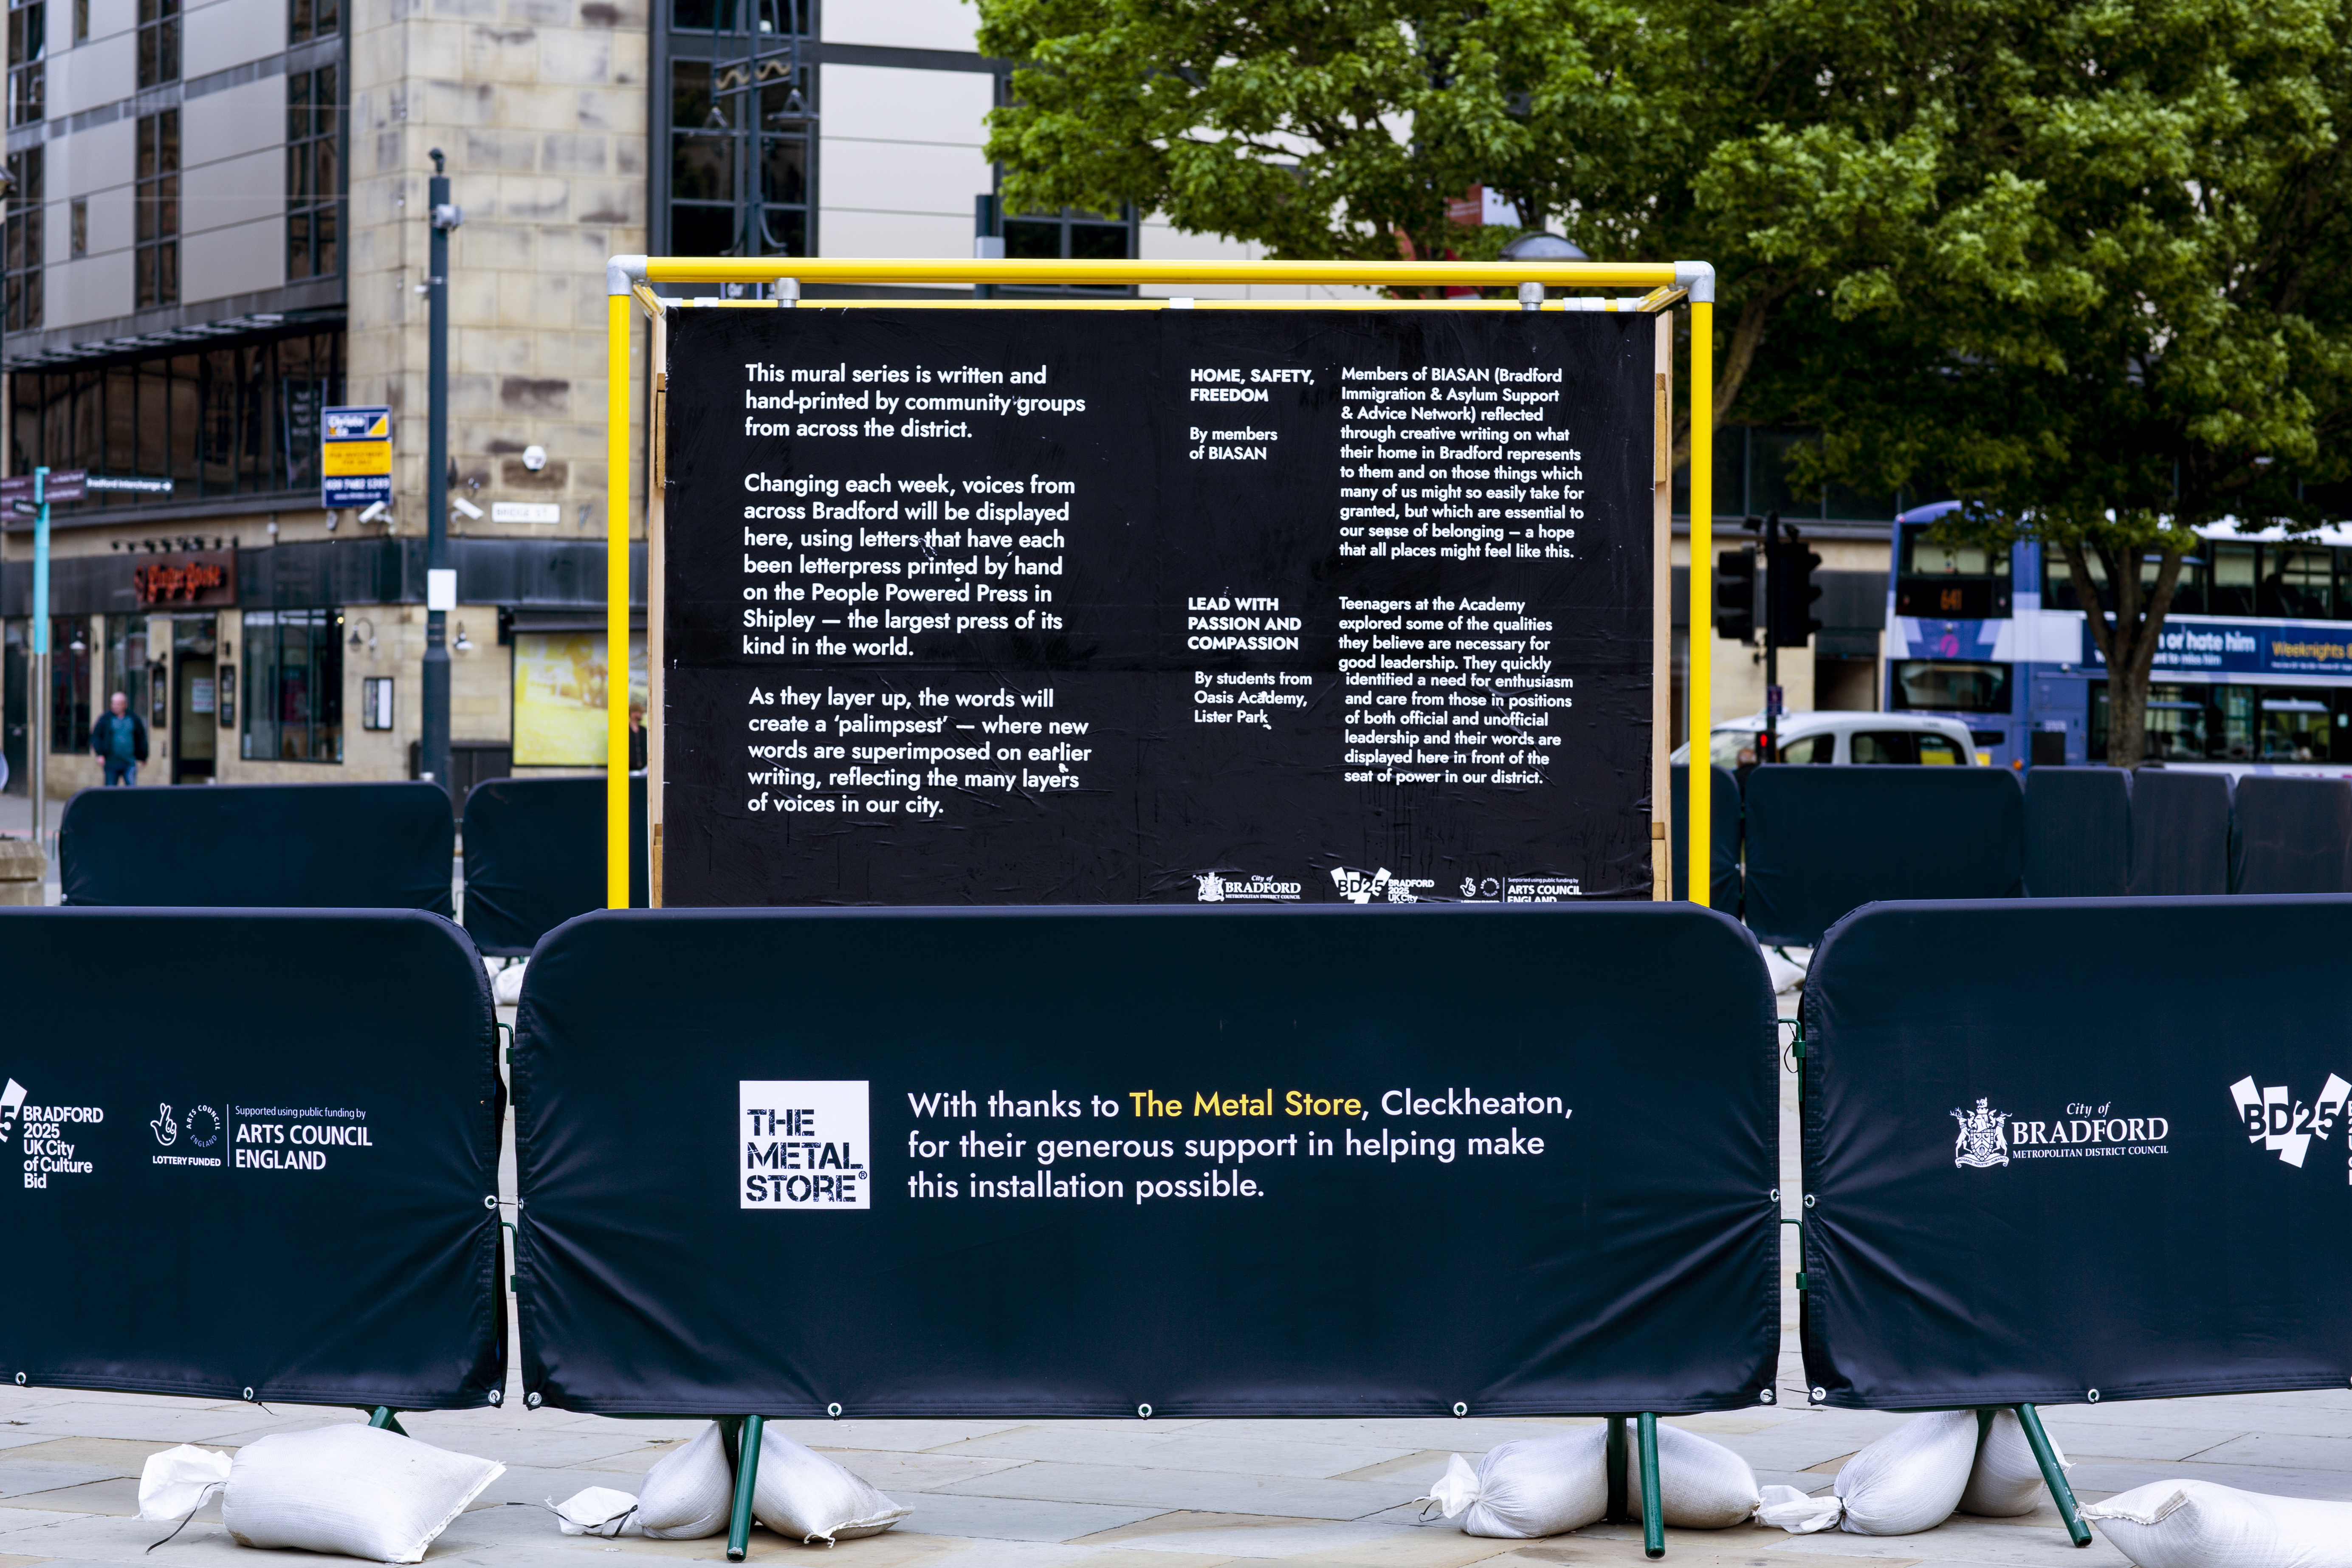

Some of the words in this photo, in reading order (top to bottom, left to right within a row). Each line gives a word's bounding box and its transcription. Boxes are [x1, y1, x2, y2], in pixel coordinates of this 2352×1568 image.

[745, 362, 784, 382] This
[792, 363, 845, 382] mural
[852, 365, 909, 382] series
[917, 365, 931, 383] is
[937, 366, 1003, 383] written
[1010, 365, 1046, 384] and
[1191, 369, 1245, 384] HOME,
[1250, 369, 1314, 385] SAFETY,
[1342, 366, 1408, 381] Members
[1413, 367, 1427, 381] of
[1432, 368, 1489, 381] BIASAN
[1495, 367, 1562, 384] (Bradford
[746, 389, 868, 414] hand-printed
[876, 390, 899, 414] by
[905, 393, 1011, 415] community
[1017, 397, 1085, 416] groups
[1191, 389, 1268, 402] FREEDOM
[1342, 386, 1425, 403] Immigration
[1430, 387, 1442, 400] &
[1446, 386, 1497, 404] Asylum
[1503, 388, 1560, 405] Support
[1341, 406, 1353, 419] &
[1357, 405, 1407, 419] Advice
[1412, 406, 1475, 423] Network)
[1481, 406, 1543, 421] reflected
[745, 416, 789, 436] from
[797, 424, 858, 437] across
[864, 417, 894, 437] the
[901, 418, 972, 437] district.
[1190, 445, 1205, 459] of
[1209, 447, 1266, 460] BIASAN
[86, 478, 117, 488] Bradford
[119, 479, 161, 491] Interchange
[745, 472, 838, 497] Changing
[846, 473, 891, 492] each
[898, 474, 955, 496] week,
[962, 476, 1024, 494] voices
[1030, 474, 1074, 494] from
[744, 506, 805, 519] across
[813, 500, 898, 519] Bradford
[905, 501, 937, 520] will
[945, 501, 969, 520] be
[976, 501, 1069, 525] displayed
[1189, 597, 1230, 610] LEAD
[1235, 598, 1278, 611] WITH
[1339, 597, 1411, 613] Teenagers
[1416, 599, 1429, 610] at
[1432, 596, 1455, 610] the
[1459, 597, 1525, 614] Academy
[1940, 588, 1962, 611] 641
[1188, 617, 1260, 630] PASSION
[1264, 618, 1301, 630] AND
[1339, 615, 1401, 632] explored
[1406, 620, 1444, 629] some
[1448, 616, 1463, 630] of
[1466, 616, 1489, 630] the
[1493, 616, 1552, 634] qualities
[1188, 636, 1298, 650] COMPASSION
[2186, 631, 2223, 651] hate
[2225, 631, 2256, 652] him
[2272, 641, 2345, 662] Weeknights
[1195, 671, 1213, 687] By
[1217, 672, 1275, 685] students
[1280, 672, 1312, 685] from
[1195, 691, 1234, 703] Oasis
[1238, 690, 1307, 708] Academy,
[1195, 710, 1232, 722] Lister
[1238, 709, 1268, 723] Park
[1226, 882, 1301, 894] BRADFORD
[1388, 880, 1434, 888] BRADFORD
[1508, 885, 1535, 894] ARTS
[1537, 885, 1582, 895] COUNCIL
[1403, 894, 1418, 903] City
[236, 1106, 276, 1117] Supported
[278, 1109, 297, 1118] using
[300, 1107, 323, 1118] public
[325, 1108, 354, 1120] funding
[356, 1108, 366, 1120] by
[908, 1090, 976, 1118] With
[988, 1090, 1081, 1117] thanks
[1091, 1095, 1119, 1117] to
[1130, 1090, 1182, 1117] The
[1194, 1089, 1272, 1116] Metal
[1285, 1091, 1368, 1120] Store,
[1382, 1088, 1572, 1119] Cleckheaton,
[2067, 1103, 2092, 1118] City
[2098, 1102, 2110, 1117] of
[23, 1106, 103, 1122] BRADFORD
[186, 1108, 196, 1129] ARTS
[198, 1105, 220, 1130] COUNCIL
[747, 1109, 815, 1136] THE
[2244, 1101, 2339, 1137] BD25
[24, 1122, 59, 1138] 2025
[236, 1124, 284, 1143] ARTS
[290, 1125, 372, 1146] COUNCIL
[2012, 1117, 2169, 1145] BRADFORD
[24, 1139, 45, 1155] UK
[46, 1140, 74, 1159] City
[190, 1134, 217, 1148] ENGLAND
[908, 1130, 950, 1157] for
[959, 1131, 1027, 1157] their
[1038, 1140, 1173, 1165] generous
[1185, 1134, 1297, 1163] support
[1309, 1131, 1332, 1155] in
[1347, 1128, 1455, 1163] helping
[1469, 1128, 1544, 1155] make
[153, 1156, 187, 1165] LOTTERY
[189, 1157, 221, 1166] FUNDED
[236, 1149, 326, 1170] ENGLAND
[747, 1142, 863, 1169] METAL
[2013, 1149, 2082, 1158] METROPOLITAN
[2086, 1147, 2126, 1156] DISTRICT
[2129, 1146, 2168, 1154] COUNCIL
[24, 1156, 39, 1171] of
[40, 1155, 93, 1173] Culture
[25, 1173, 46, 1188] Bid
[908, 1171, 958, 1198] this
[970, 1170, 1123, 1197] installation
[1137, 1170, 1263, 1204] possible.
